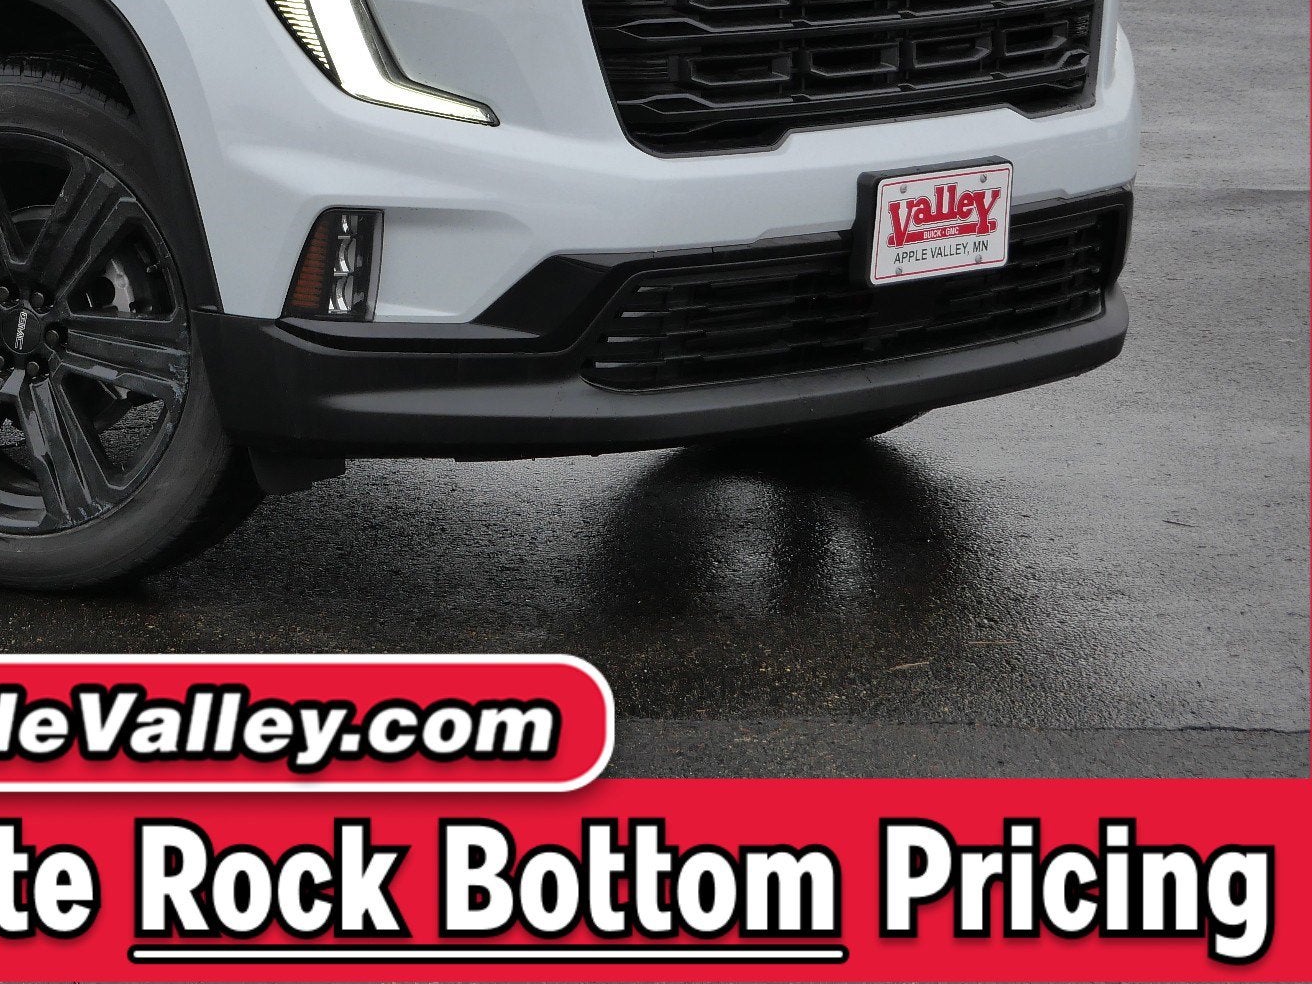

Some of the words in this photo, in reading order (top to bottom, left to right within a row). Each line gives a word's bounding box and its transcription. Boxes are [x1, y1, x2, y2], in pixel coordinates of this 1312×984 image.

[923, 228, 942, 239] BUICK
[945, 226, 960, 236] GMC
[893, 248, 928, 265] APPLE
[930, 242, 970, 259] VALLEY,
[972, 240, 989, 253] MN
[14, 311, 28, 350] GMC
